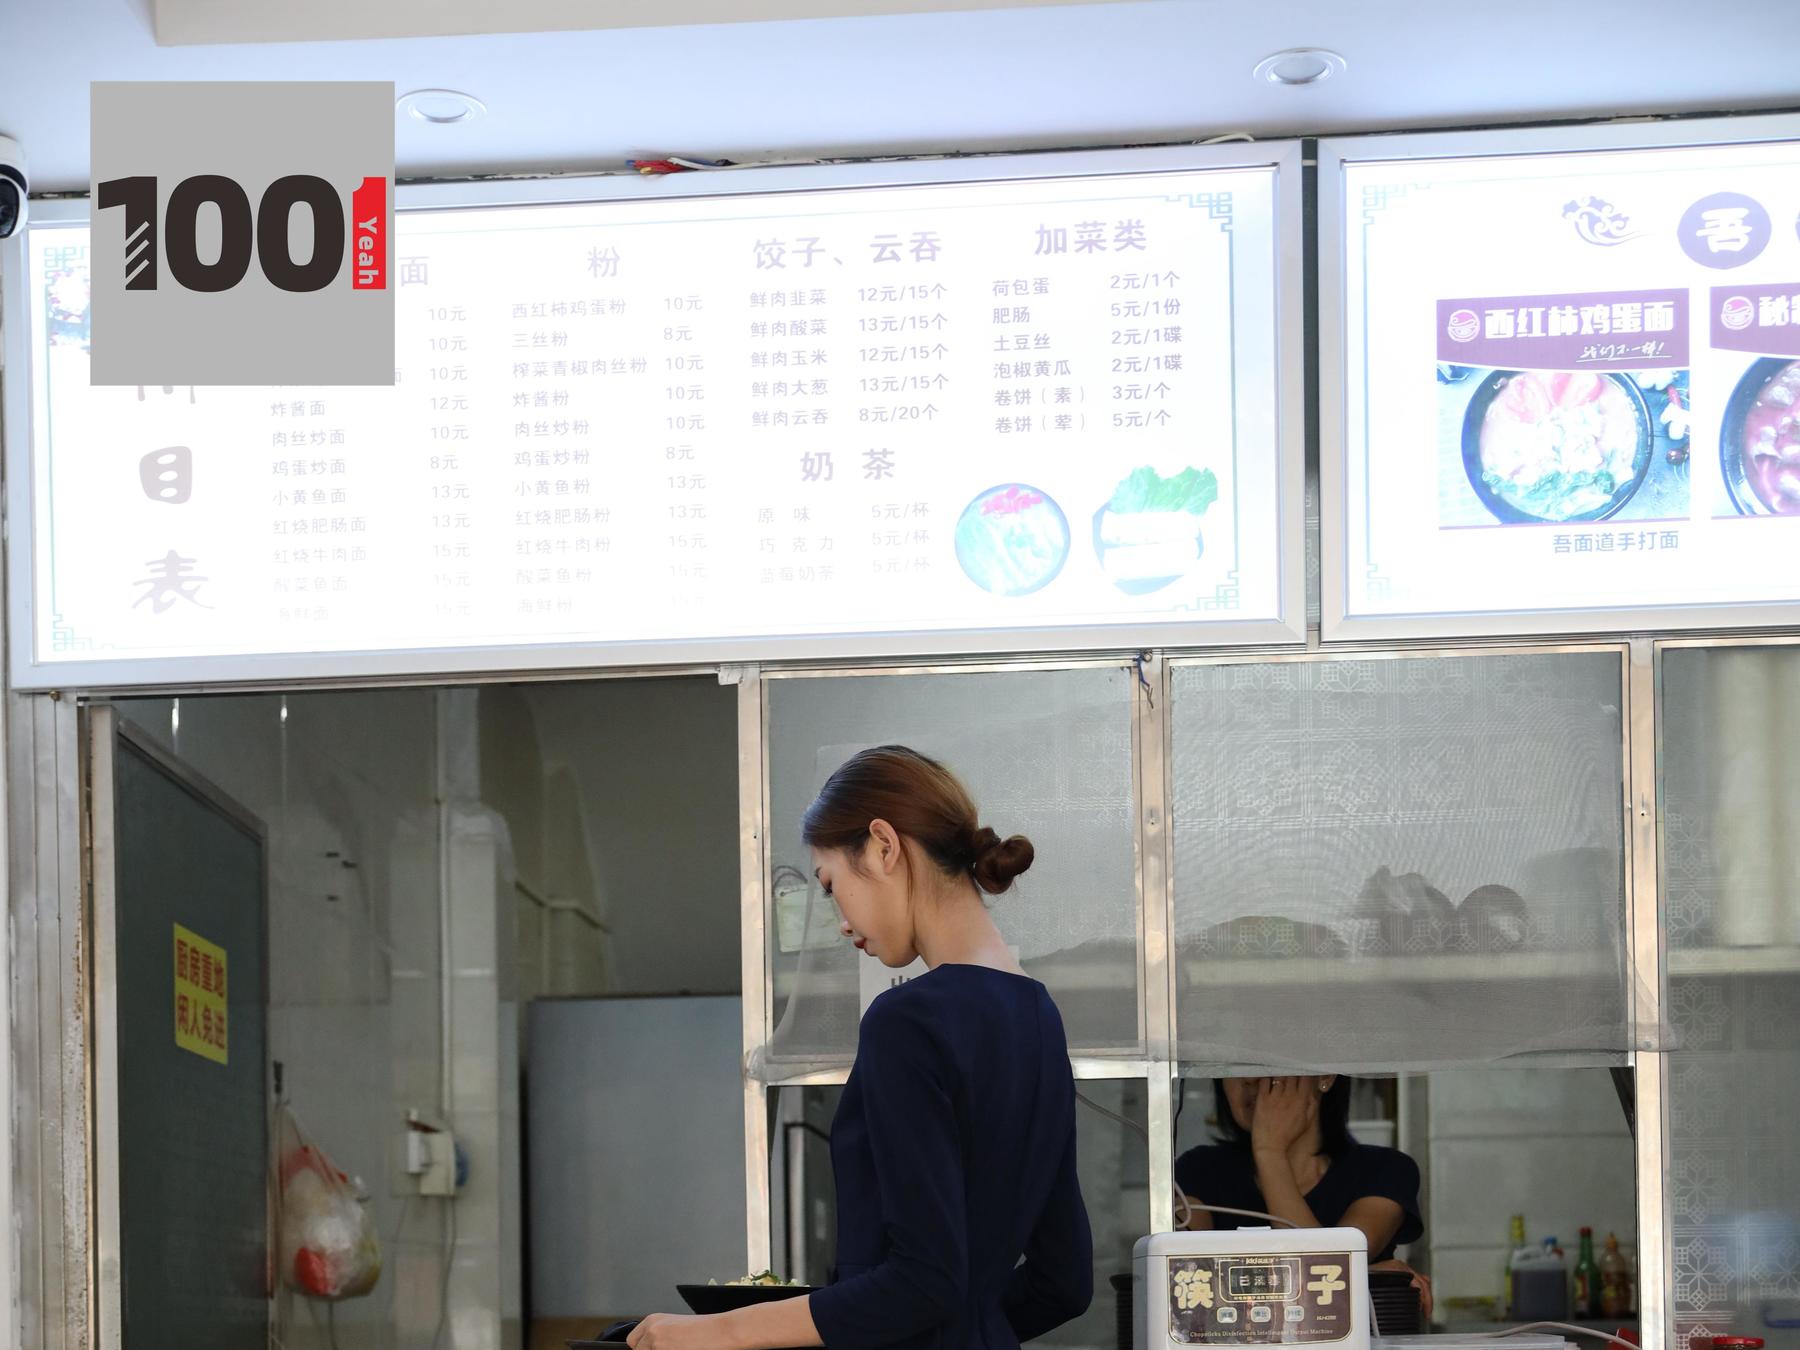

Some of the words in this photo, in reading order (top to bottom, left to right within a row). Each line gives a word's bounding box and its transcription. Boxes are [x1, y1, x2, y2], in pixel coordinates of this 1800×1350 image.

[1034, 218, 1147, 256] 加菜类
[1695, 207, 1753, 254] 吾
[587, 245, 621, 279] 粉
[752, 231, 942, 270] 饺子、云吞
[749, 288, 826, 308] 鲜肉韭菜
[857, 282, 948, 303] 12元/15个
[992, 276, 1050, 297] 荷包蛋
[1109, 270, 1181, 290] 2元/1个
[428, 305, 467, 322] 10元
[512, 298, 627, 319] 西红柿鸡蛋粉
[664, 294, 704, 312] 10元
[992, 305, 1031, 325] 肥肠
[1110, 298, 1182, 318] 5元/1份
[750, 318, 827, 338] 鲜肉酸菜
[858, 312, 948, 333] 13元/15个
[1484, 300, 1675, 340] 西红柿鸡蛋面
[428, 335, 468, 352] 10元
[512, 330, 569, 348] 三丝粉
[663, 325, 693, 342] 8元
[993, 332, 1051, 352] 土豆丝
[1111, 325, 1182, 346] 2元/1碟
[512, 357, 648, 378] 榨菜青椒肉丝粉
[665, 354, 705, 371] 10元
[750, 348, 828, 368] 鲜肉玉米
[859, 342, 949, 363] 12元/15个
[993, 359, 1072, 380] 泡椒黄瓜
[1111, 353, 1183, 373] 2元/1碟
[429, 364, 468, 382] 10元
[751, 378, 828, 398] 鲜肉大葱
[859, 372, 949, 393] 13元/15个
[512, 390, 570, 408] 炸酱粉
[665, 384, 705, 401] 10元
[1112, 381, 1171, 401] 3元/个
[270, 400, 326, 417] 炸酱面
[430, 394, 469, 411] 12元
[751, 408, 829, 427] 鲜肉云吞
[858, 403, 939, 423] 8元/20个
[514, 419, 590, 438] 肉丝炒粉
[666, 414, 706, 431] 10元
[1112, 408, 1172, 428] 5元/个
[272, 428, 345, 448] 肉丝炒面
[430, 424, 470, 441] 10元
[272, 458, 346, 477] 鸡蛋炒面
[429, 454, 459, 471] 8元
[514, 449, 590, 467] 鸡蛋炒粉
[665, 444, 695, 461] 8元
[272, 487, 346, 506] 小黄鱼面
[431, 483, 471, 500] 13元
[514, 478, 591, 497] 小黄鱼粉
[667, 473, 707, 490] 13元
[515, 507, 611, 526] 红烧肥肠粉
[668, 503, 707, 520] 13元
[871, 502, 930, 519] 5元/杯
[273, 516, 366, 535] 红烧肥肠面
[432, 512, 471, 529] 13元
[515, 537, 611, 556] 红烧牛肉粉
[871, 529, 930, 547] 5元/杯
[1552, 529, 1680, 555] 吾面道手打面
[273, 545, 367, 564] 红烧牛肉面
[872, 556, 931, 573] 5元/杯
